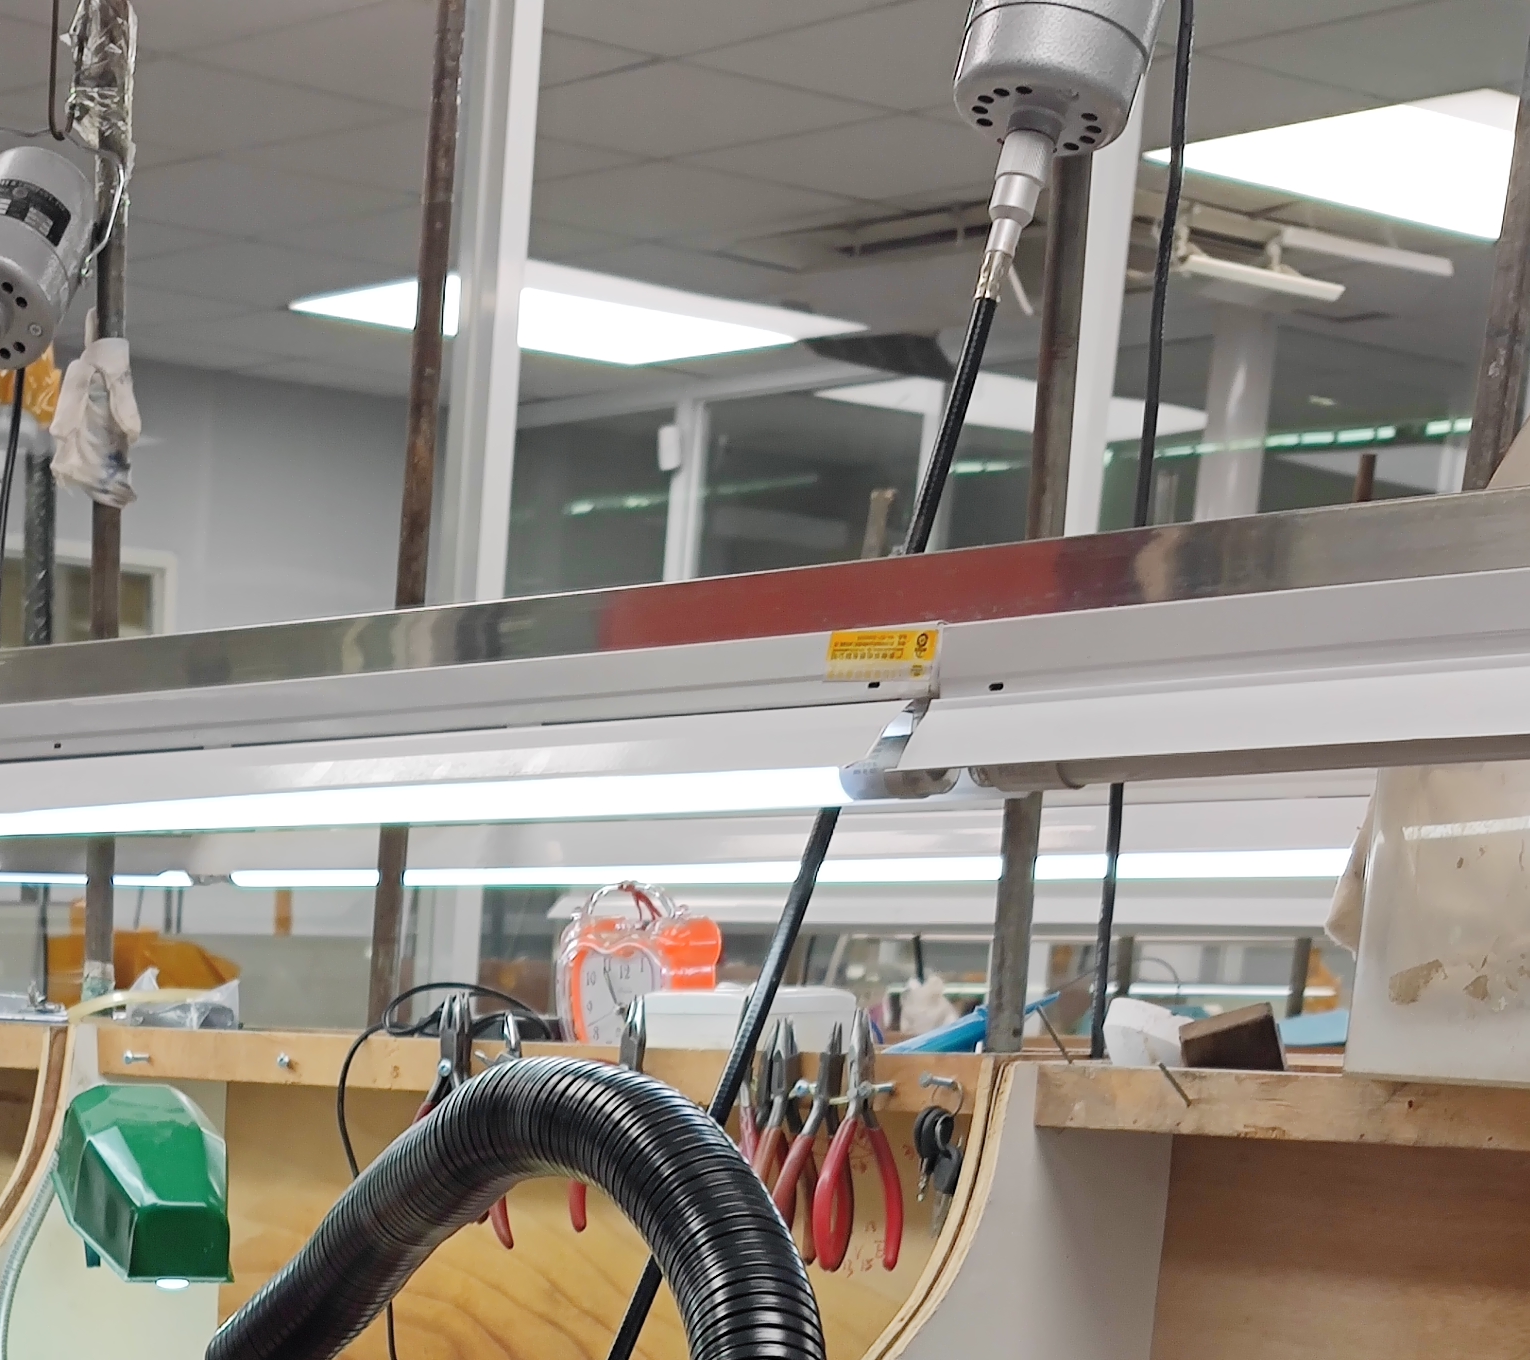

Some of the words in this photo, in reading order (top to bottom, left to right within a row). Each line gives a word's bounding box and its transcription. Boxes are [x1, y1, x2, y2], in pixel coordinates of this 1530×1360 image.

[586, 971, 596, 986] 10
[619, 965, 630, 980] 12
[586, 1000, 593, 1012] 9
[593, 1026, 599, 1041] 8
